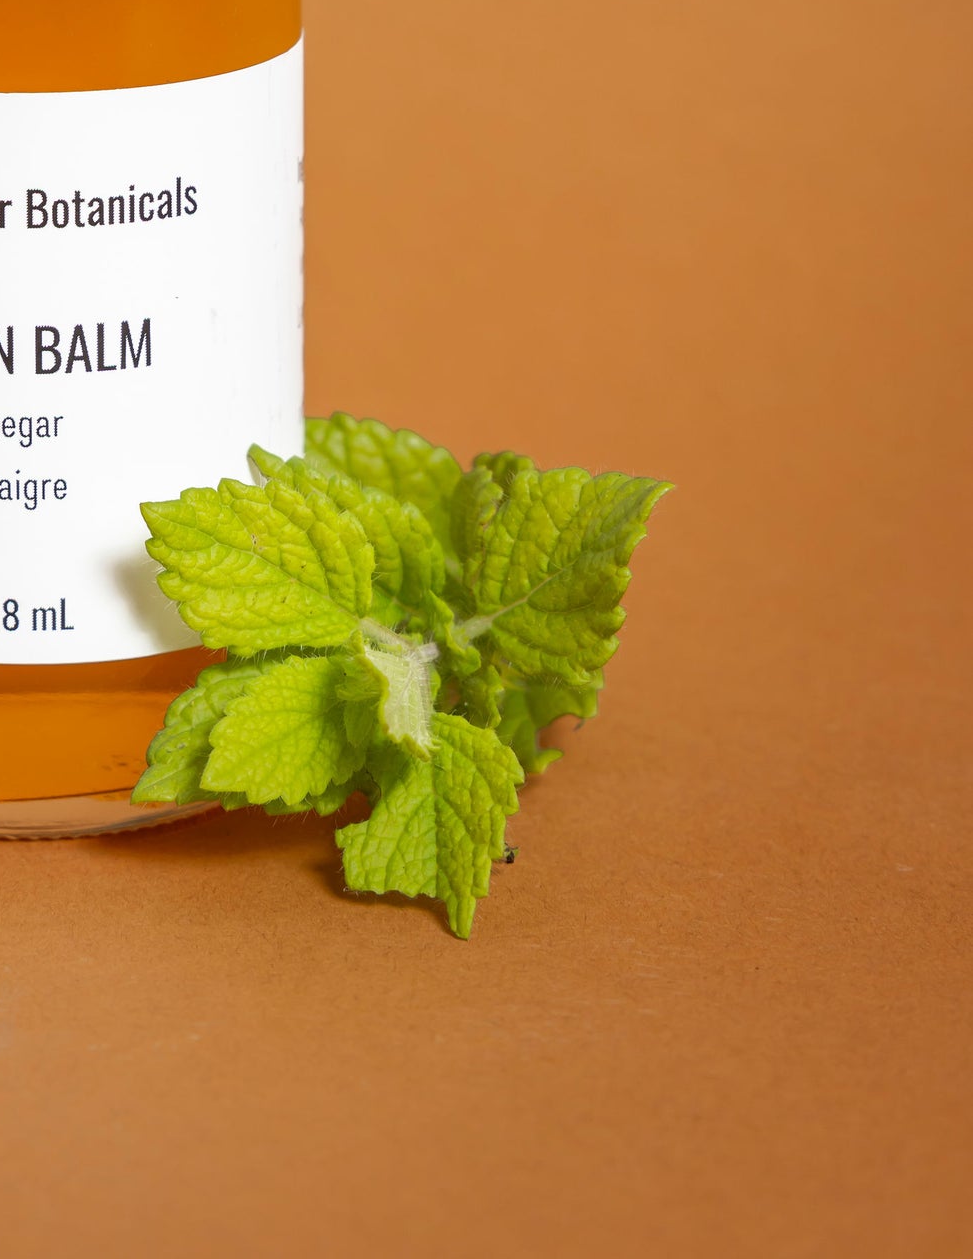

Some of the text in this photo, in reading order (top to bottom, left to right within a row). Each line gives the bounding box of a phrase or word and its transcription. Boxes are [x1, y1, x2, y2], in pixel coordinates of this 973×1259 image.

[26, 176, 198, 230] Botanicals
[34, 317, 152, 375] BALM
[31, 597, 75, 632] mL
